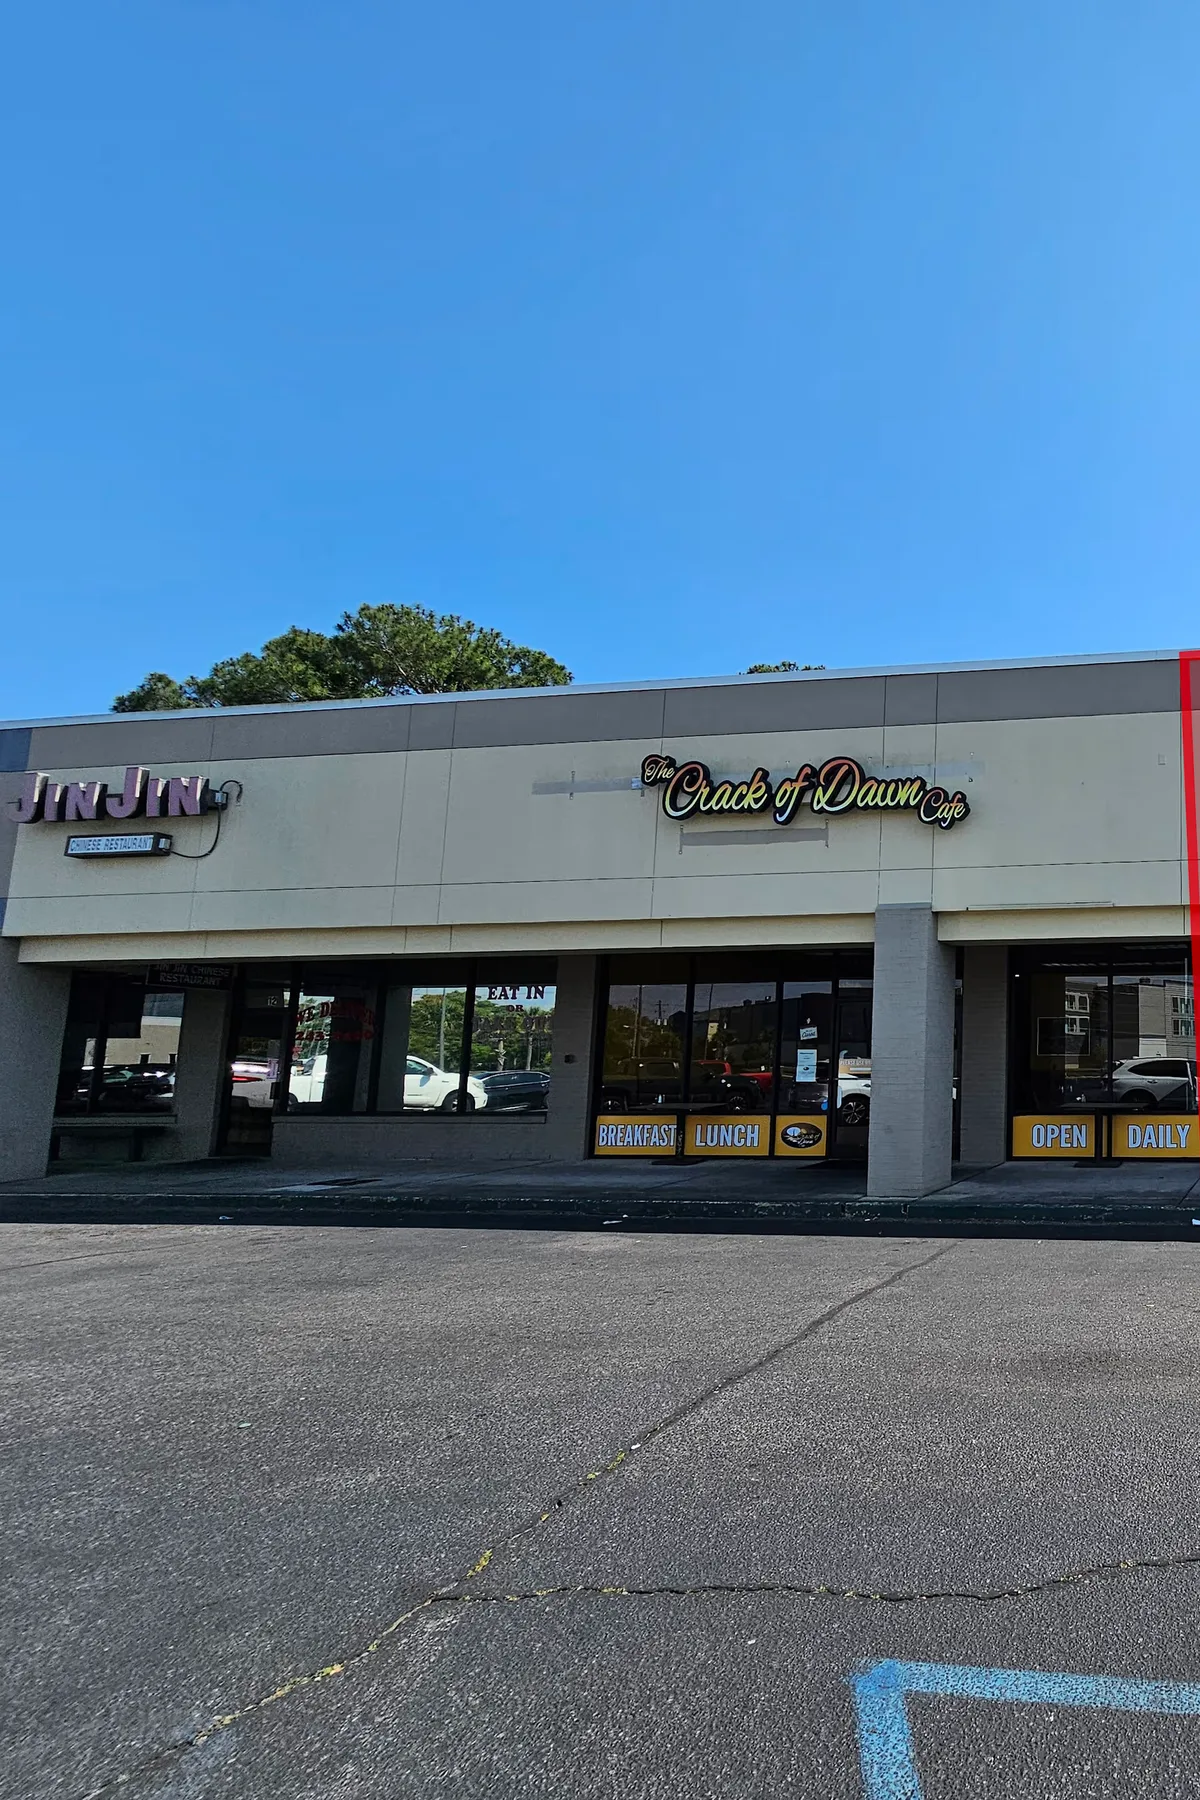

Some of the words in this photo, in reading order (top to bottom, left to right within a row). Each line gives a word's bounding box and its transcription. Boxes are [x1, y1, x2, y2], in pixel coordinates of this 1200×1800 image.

[644, 756, 676, 783] The
[662, 764, 768, 818] Crack
[773, 763, 812, 823] of
[812, 759, 924, 813] Dawn
[918, 789, 966, 828] Cafe
[70, 838, 101, 852] CHINESE
[103, 837, 154, 851] RESTAURANT
[159, 972, 222, 986] RESTAURANT
[191, 965, 231, 977] CHINESE
[487, 985, 520, 1000] EAT
[525, 985, 545, 1000] IN
[506, 1004, 525, 1013] OR
[598, 1124, 678, 1147] BREAKFAST
[695, 1124, 760, 1147] LUNCH
[1032, 1124, 1087, 1148] OPEN
[1127, 1124, 1191, 1148] DAILY
